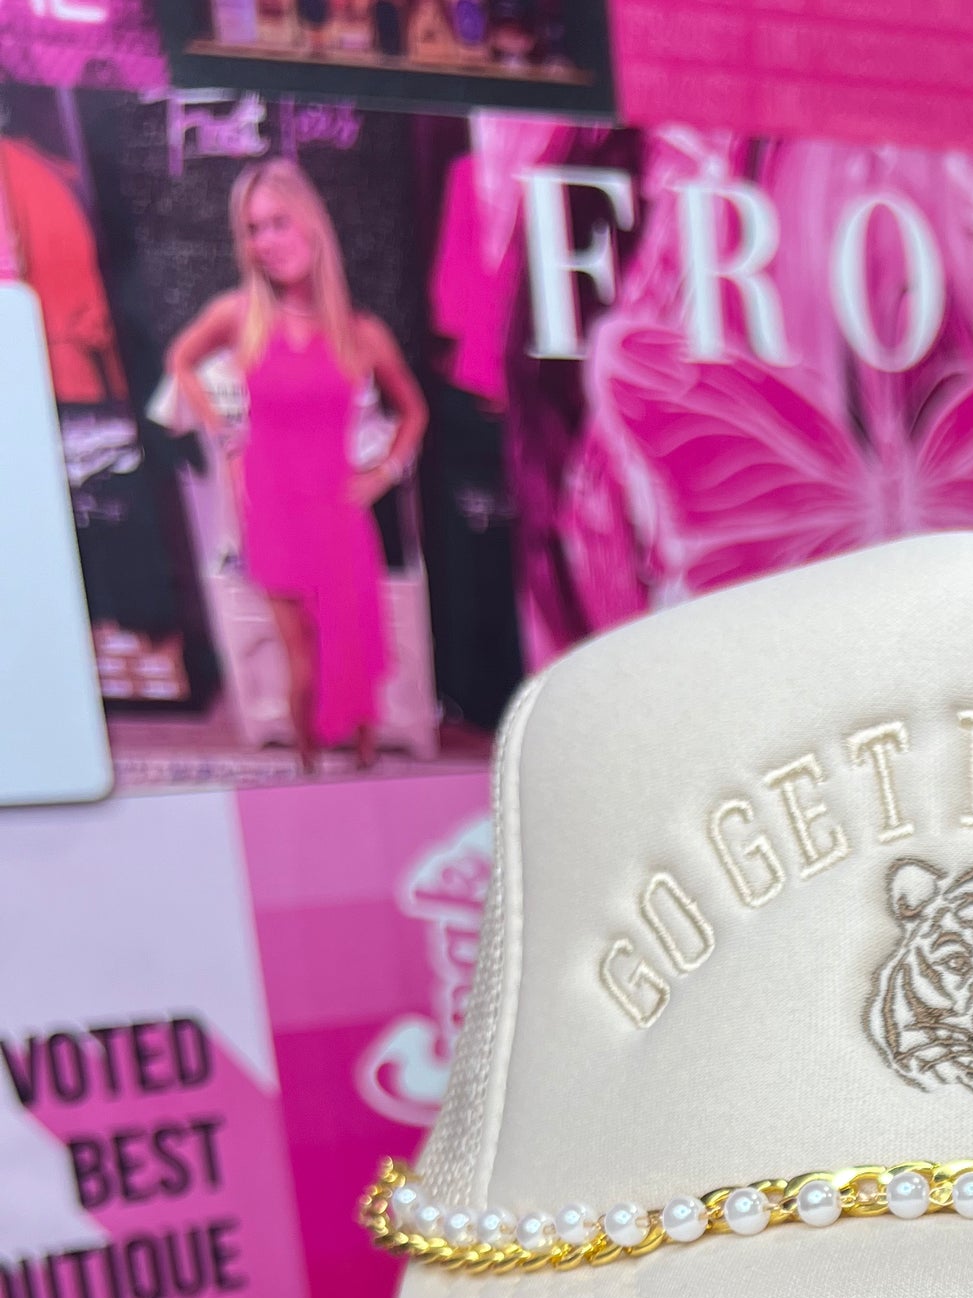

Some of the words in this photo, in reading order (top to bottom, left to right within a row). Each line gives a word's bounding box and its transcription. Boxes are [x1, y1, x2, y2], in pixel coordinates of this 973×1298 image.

[599, 871, 716, 1030] GO
[705, 721, 916, 909] GET
[0, 1017, 214, 1108] VOTED
[65, 1113, 225, 1212] BEST
